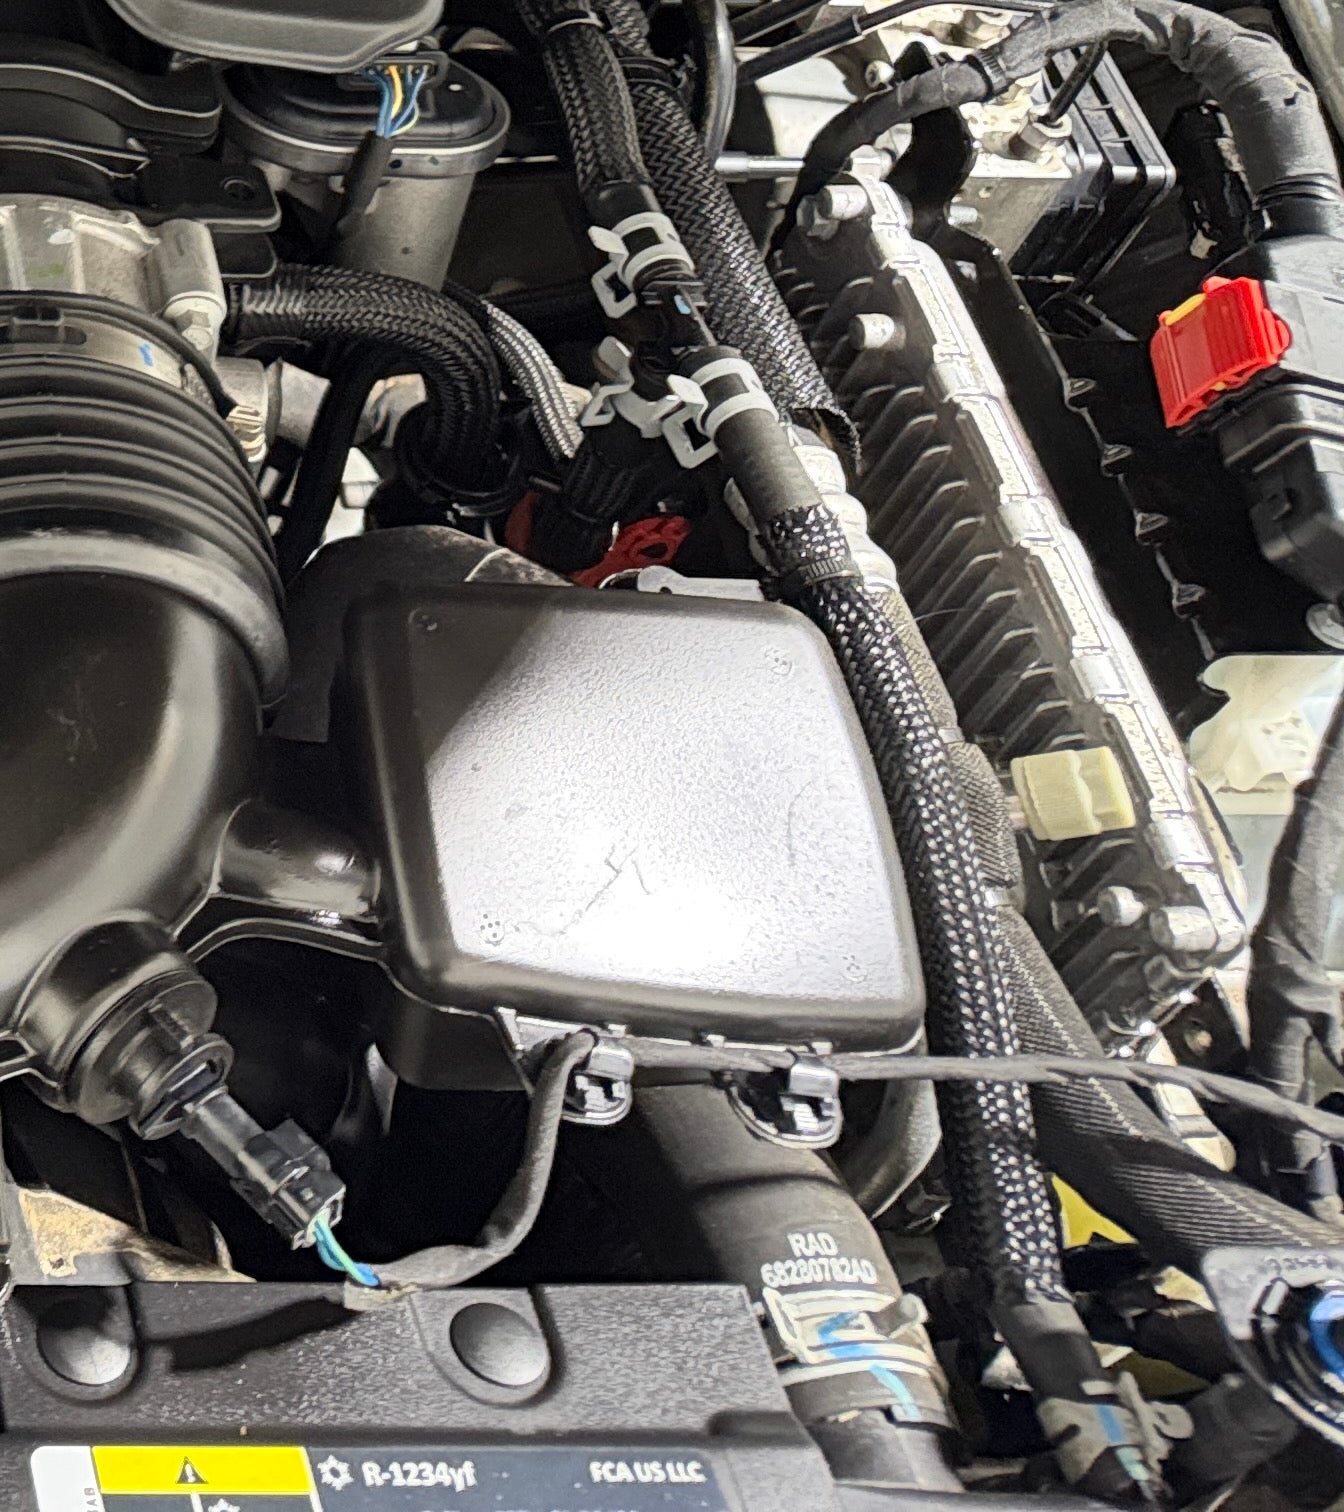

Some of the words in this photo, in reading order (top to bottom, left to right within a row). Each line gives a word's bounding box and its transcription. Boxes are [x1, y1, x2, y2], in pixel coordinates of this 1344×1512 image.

[787, 1231, 839, 1257] RAD
[361, 1460, 479, 1492] R-1234yf
[589, 1461, 634, 1483] FCA
[634, 1461, 664, 1483] US
[665, 1461, 708, 1483] LLC
